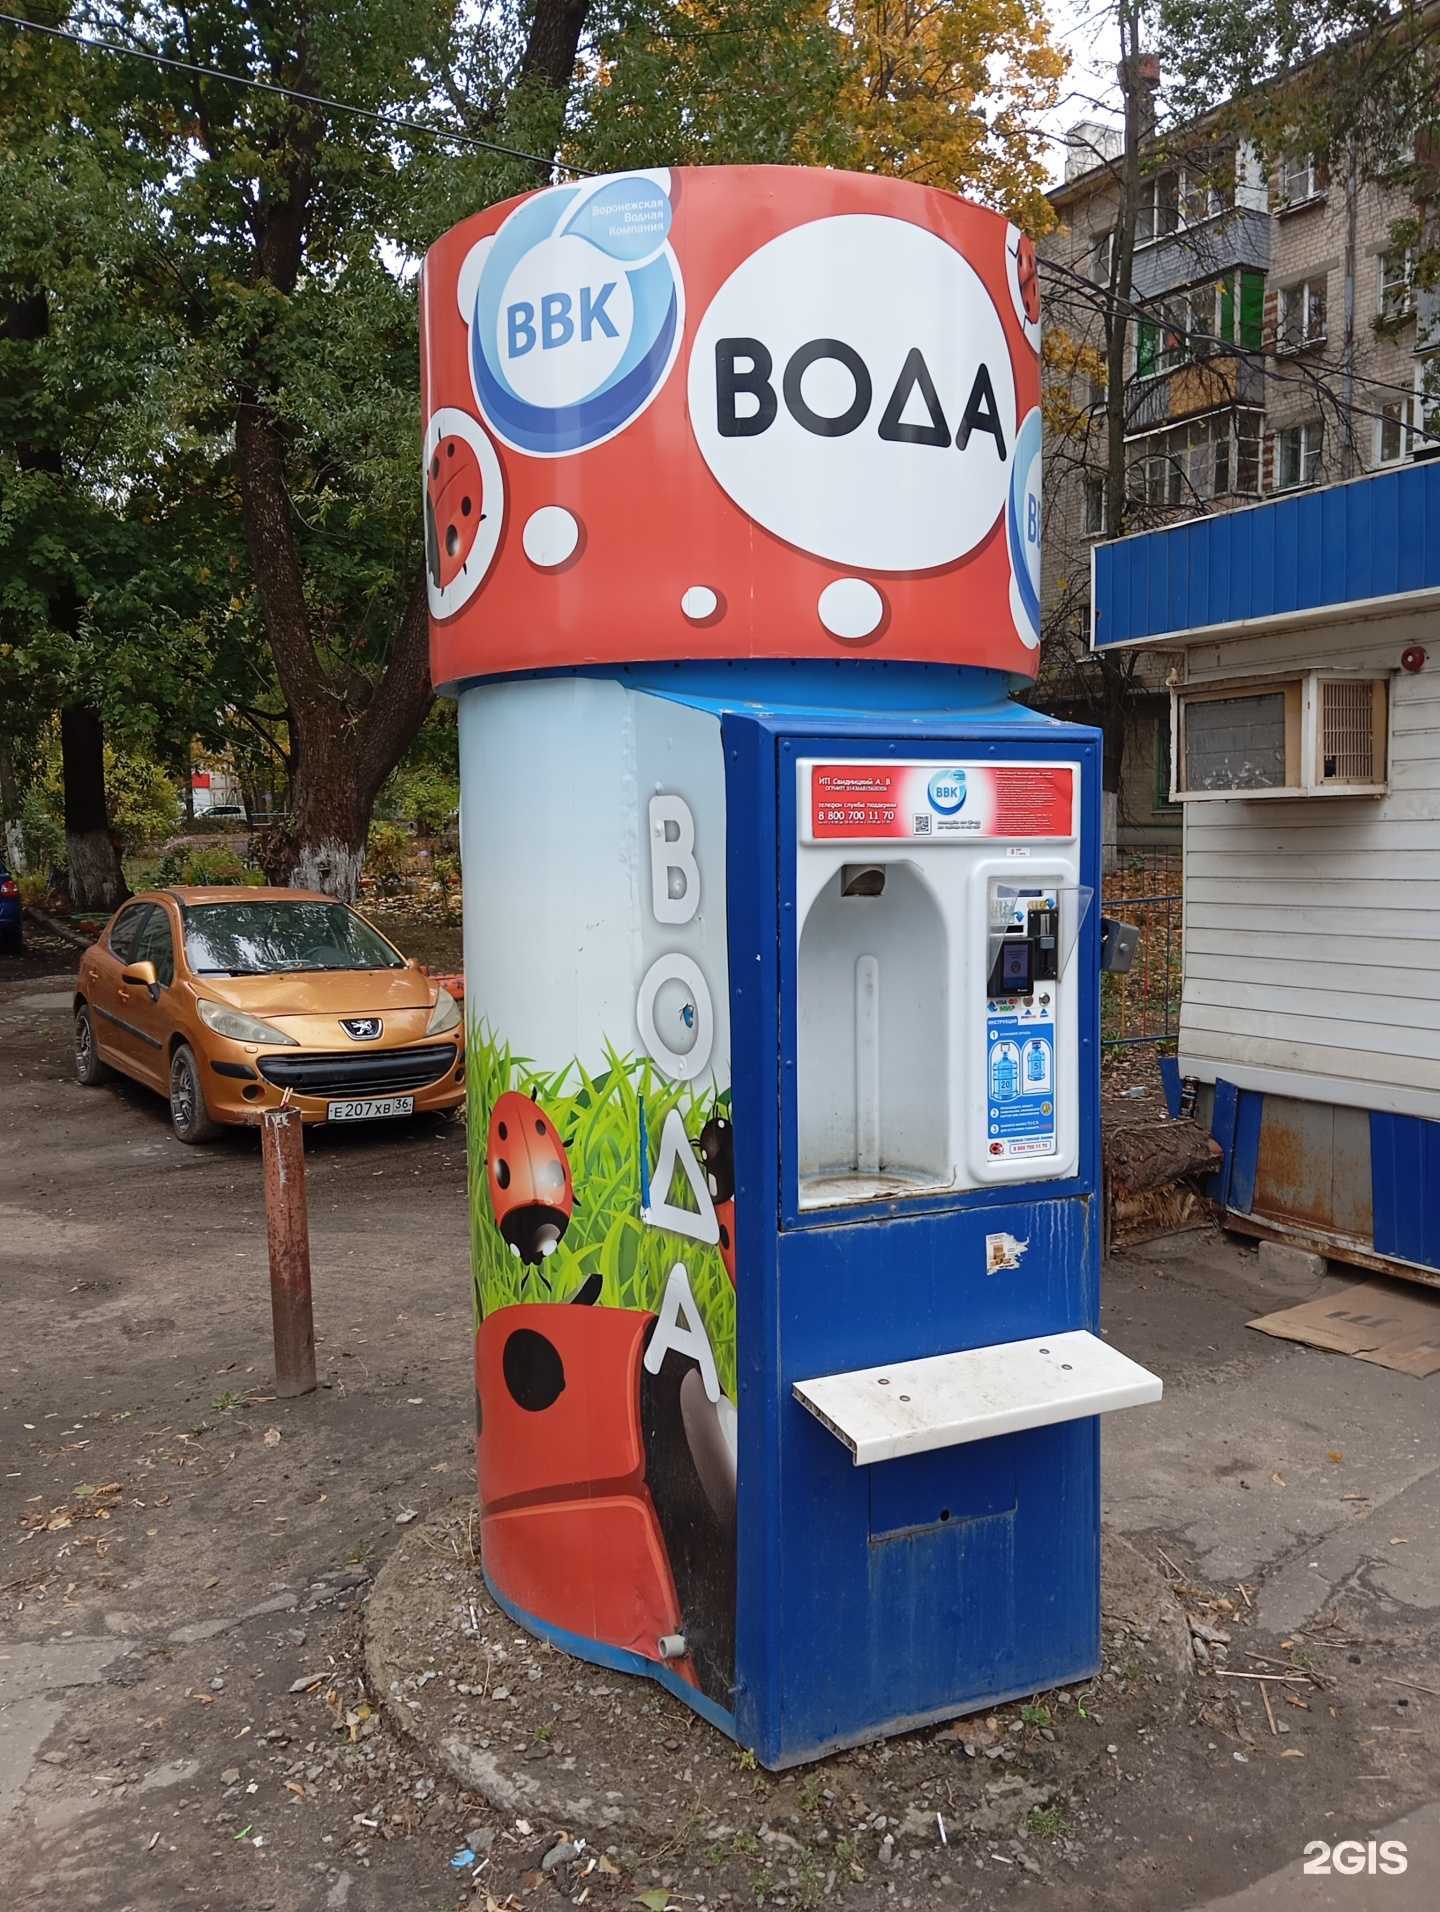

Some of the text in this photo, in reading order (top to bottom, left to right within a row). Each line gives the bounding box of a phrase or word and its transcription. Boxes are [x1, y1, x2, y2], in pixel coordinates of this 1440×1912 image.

[624, 210, 664, 223] Водная
[507, 282, 620, 359] ВВК
[715, 337, 1007, 462] ВОДА
[936, 786, 958, 798] ВВК
[818, 811, 895, 820] 8 800 700 11 70
[636, 794, 721, 1403] ВОДА
